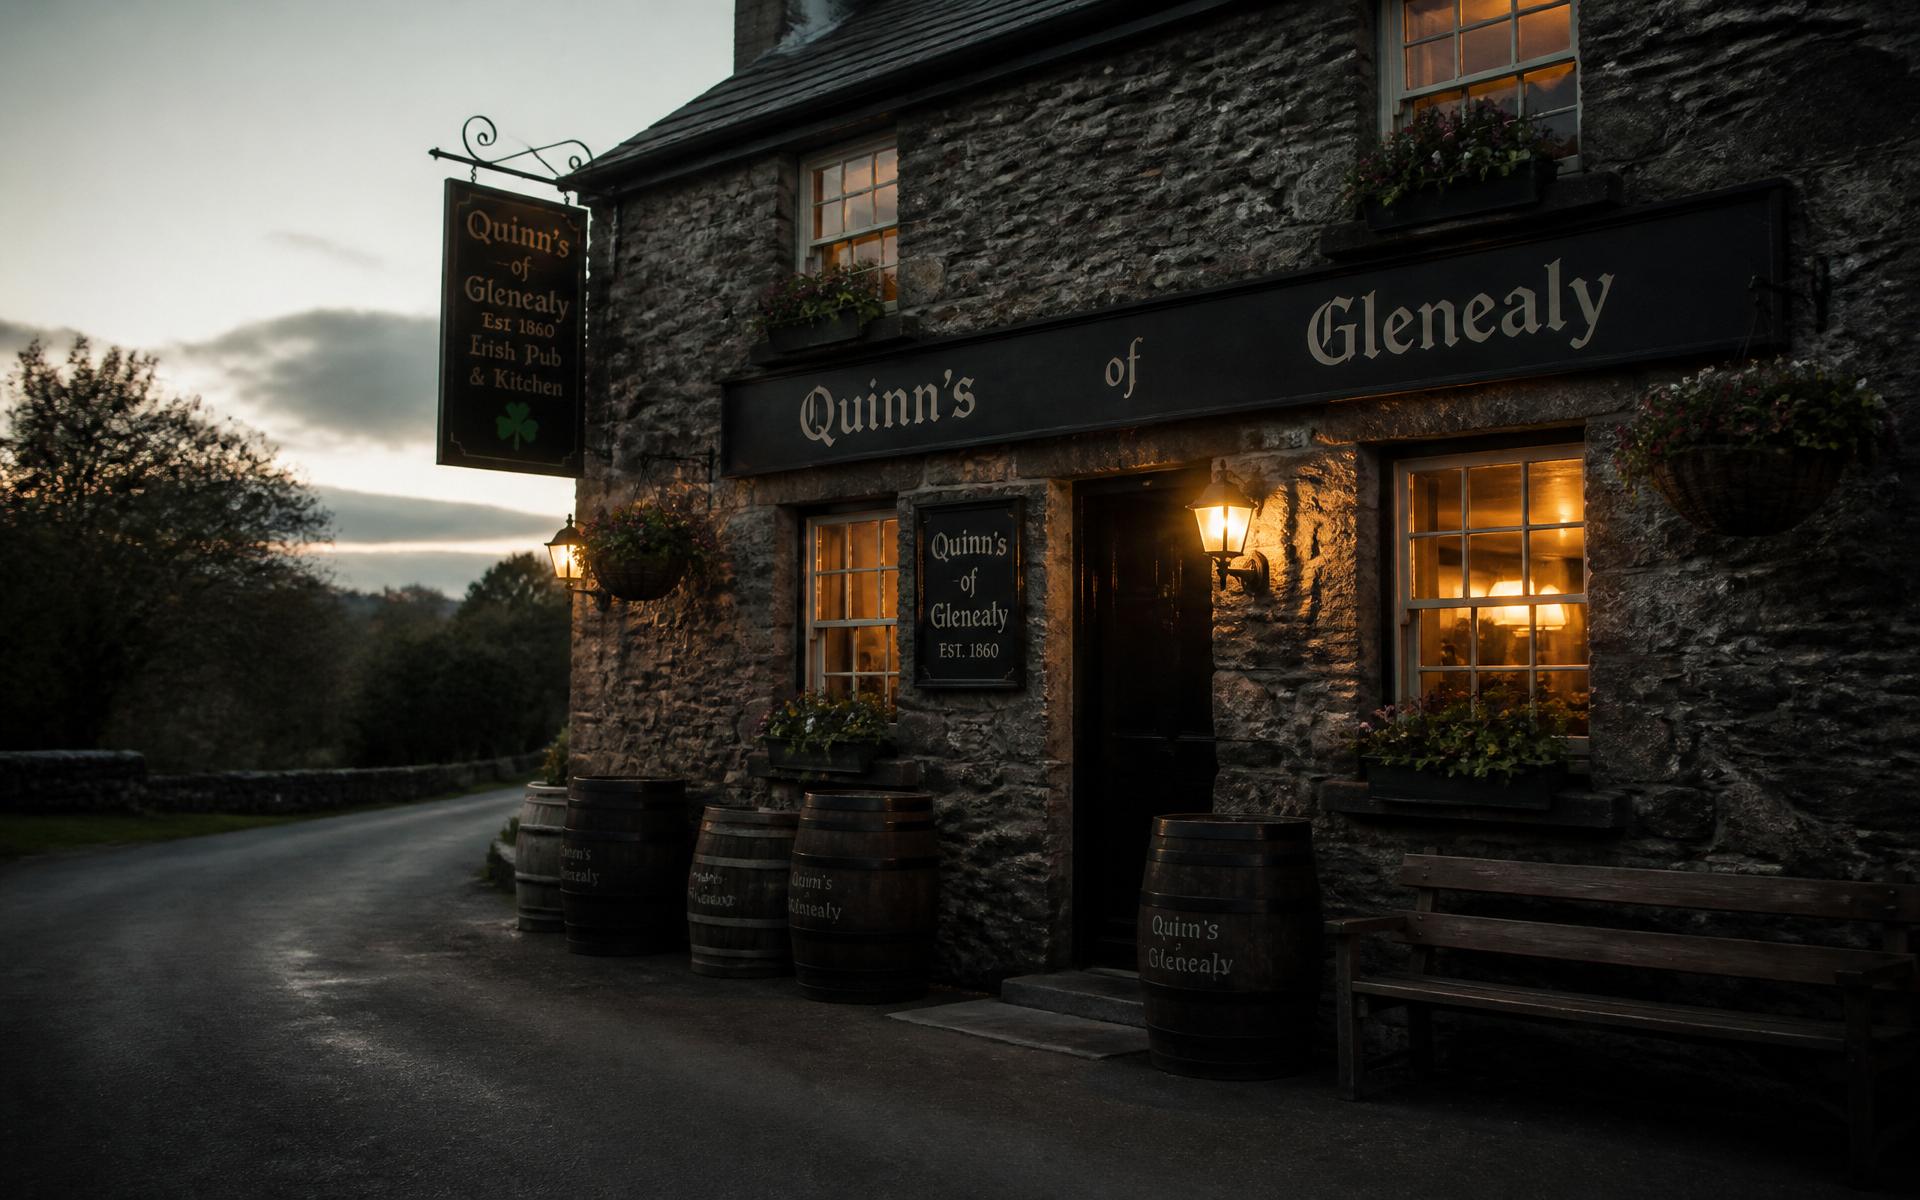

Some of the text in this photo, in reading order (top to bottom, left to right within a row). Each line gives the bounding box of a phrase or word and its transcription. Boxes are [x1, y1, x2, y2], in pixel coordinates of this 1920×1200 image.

[467, 209, 570, 258] Quinn's
[511, 256, 532, 282] of
[465, 275, 570, 323] Glenealy
[518, 317, 555, 338] 1860
[524, 343, 562, 368] Pub
[799, 257, 1616, 448] Quinn's of Glenealy
[470, 366, 563, 397] & Kitchen
[931, 529, 1008, 563] Quinn's
[960, 566, 978, 598] of
[930, 600, 1009, 634] Glenealy
[938, 642, 999, 659] EST. 1860
